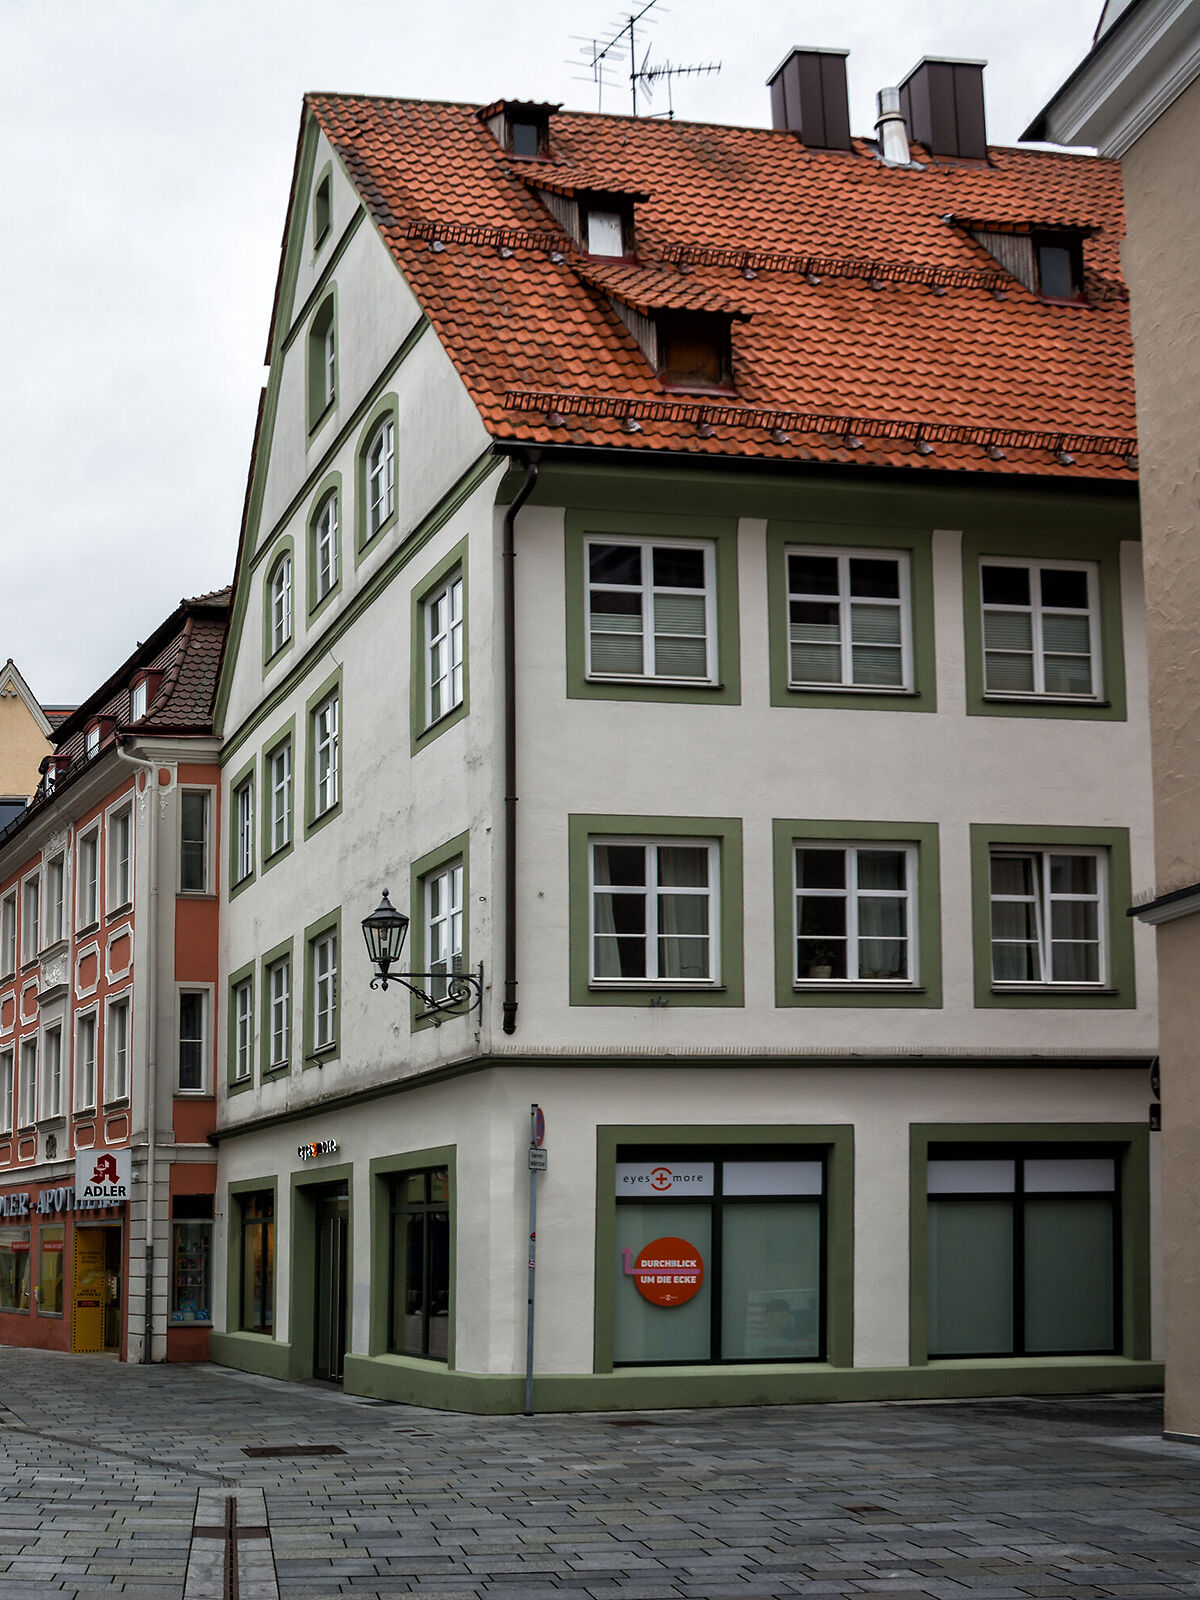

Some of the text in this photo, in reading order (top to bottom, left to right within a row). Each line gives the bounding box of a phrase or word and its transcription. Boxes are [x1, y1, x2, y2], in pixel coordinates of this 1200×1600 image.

[622, 1173, 704, 1185] eyes more
[84, 1186, 126, 1197] ADLER
[640, 1259, 697, 1268] DURCHBLICK
[640, 1276, 697, 1284] UM DIE ECKE
